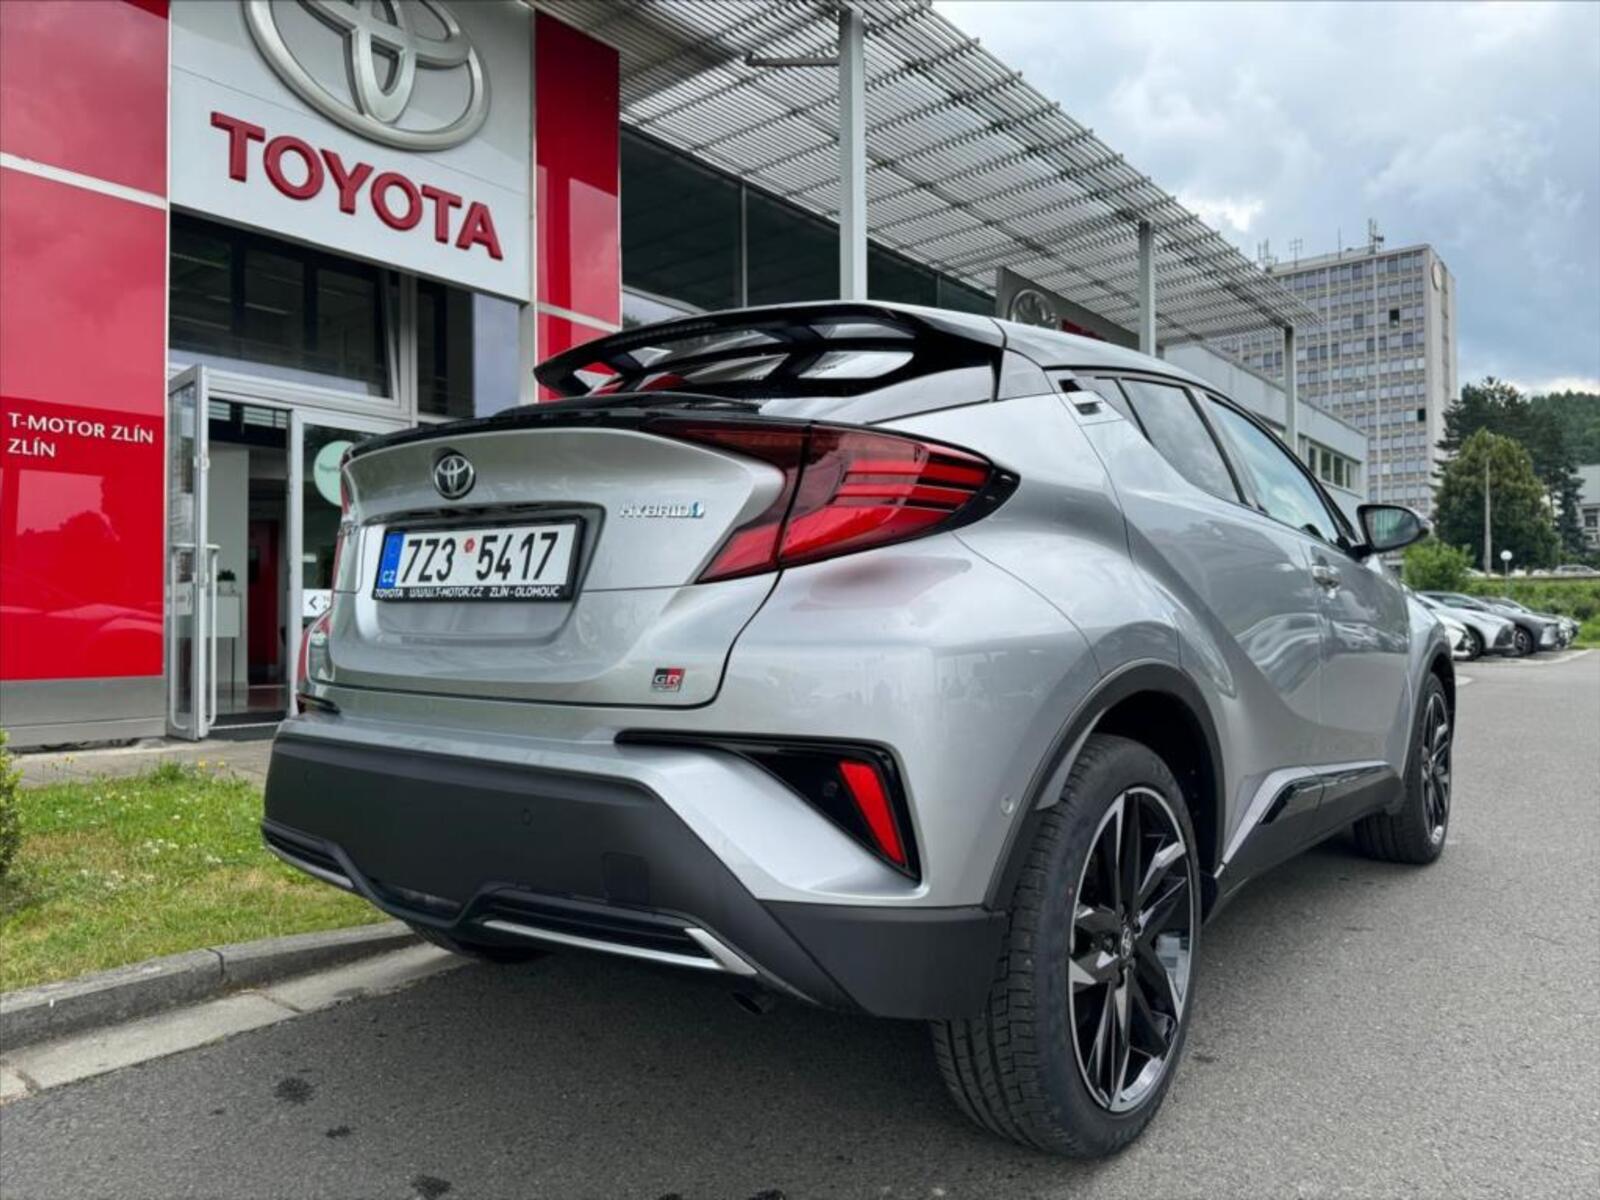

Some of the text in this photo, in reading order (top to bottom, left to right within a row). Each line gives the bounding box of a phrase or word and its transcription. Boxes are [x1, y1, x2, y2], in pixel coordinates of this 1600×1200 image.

[210, 111, 503, 261] TOYOTA
[8, 411, 154, 444] T-MOTOR ZLÍN
[7, 436, 56, 458] ZLÍN
[620, 503, 688, 518] HYBRID
[401, 532, 558, 583] 7Z3 5417
[382, 570, 396, 583] CZ
[375, 588, 404, 599] TOYOTA
[514, 585, 560, 598] OLOMOUC
